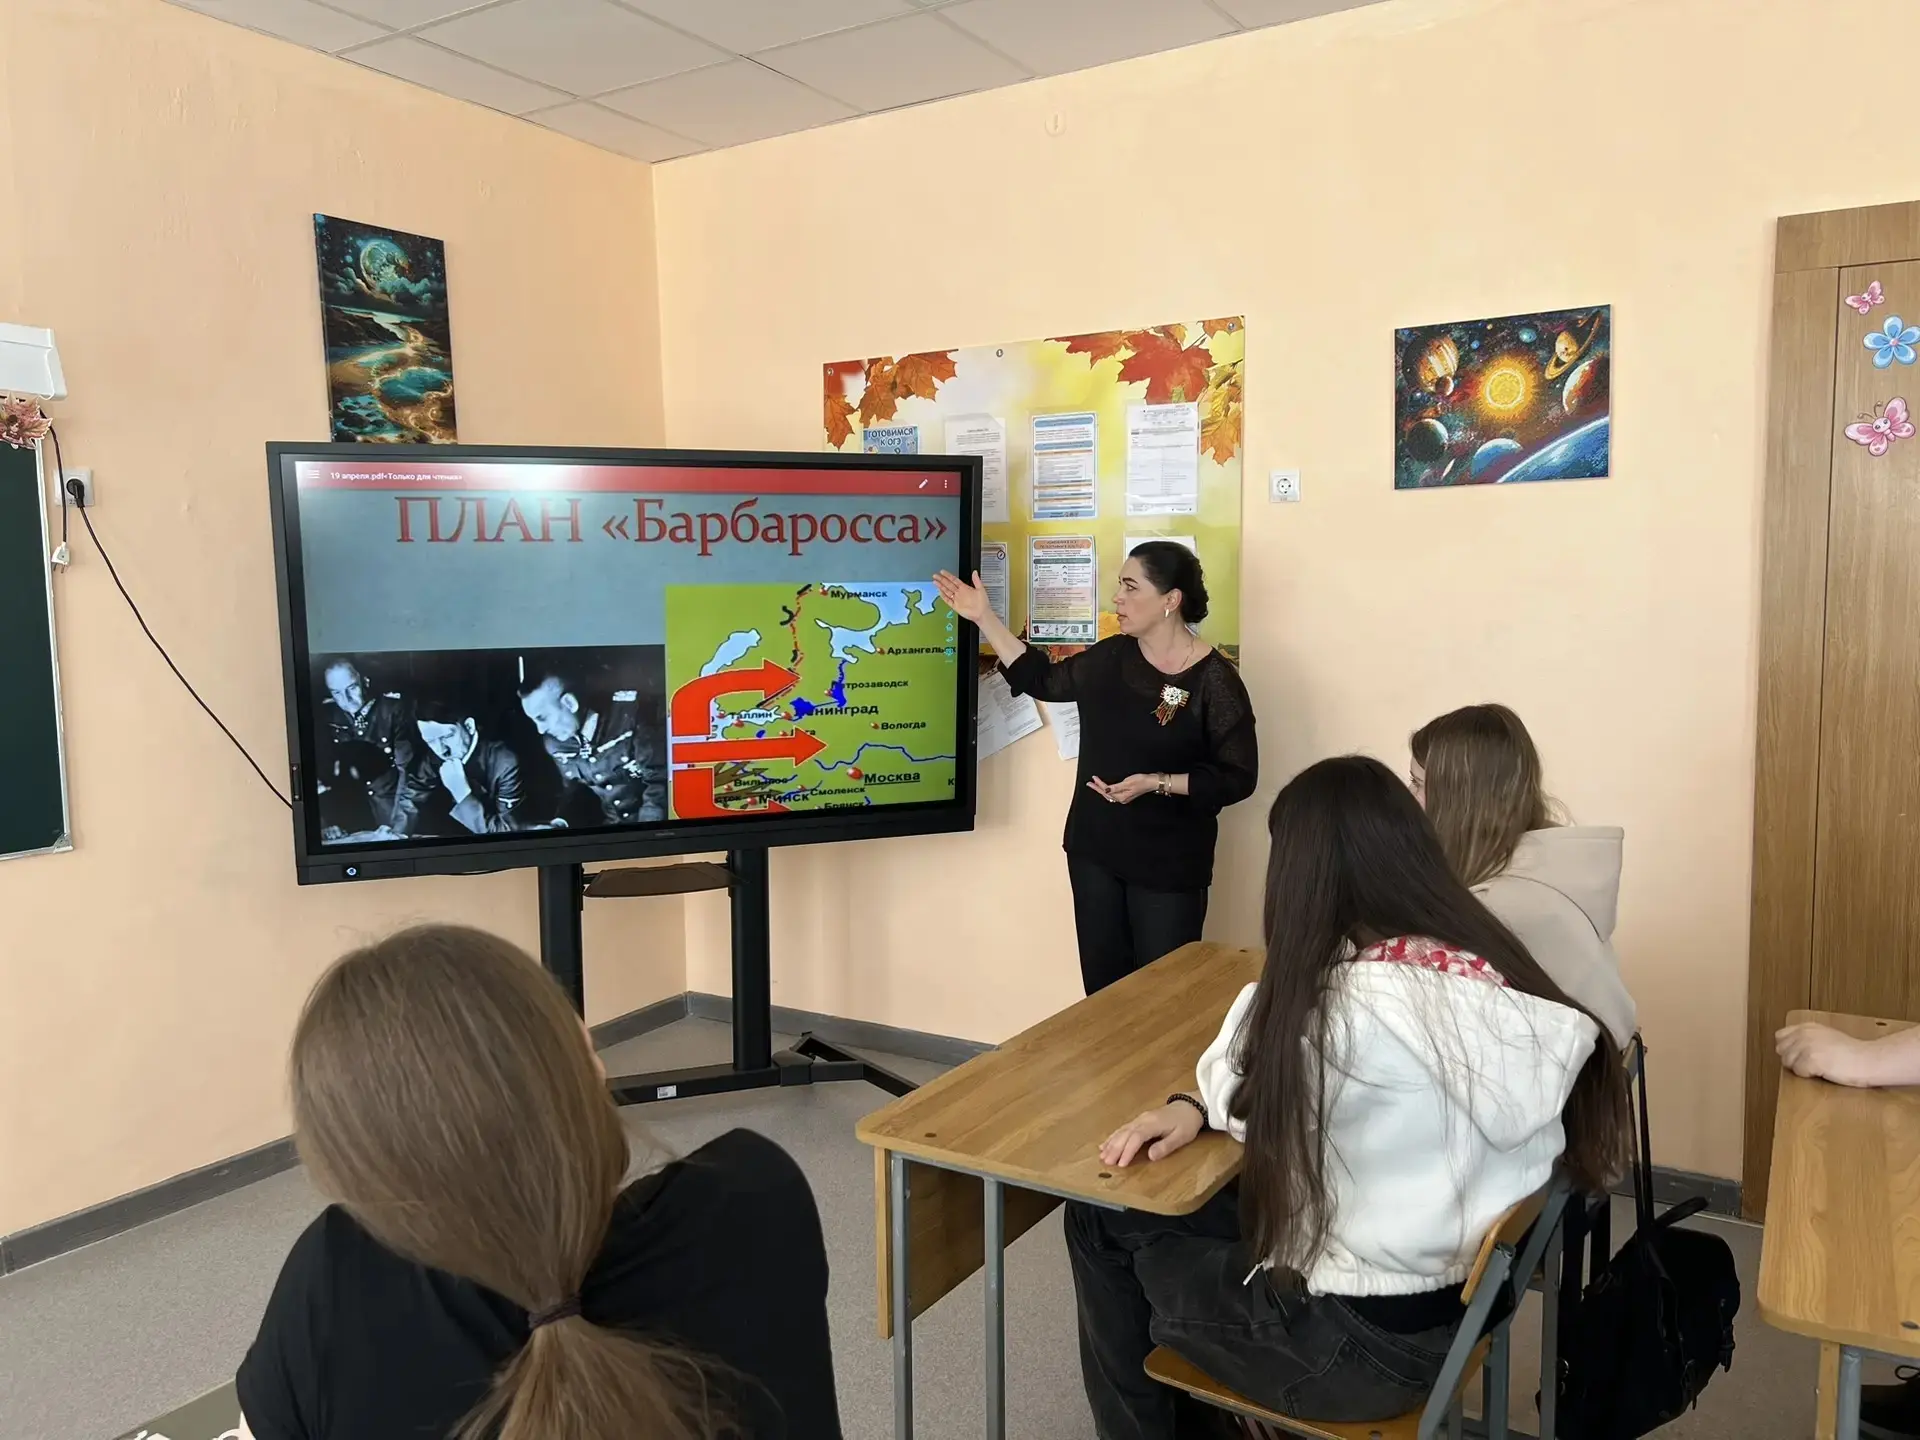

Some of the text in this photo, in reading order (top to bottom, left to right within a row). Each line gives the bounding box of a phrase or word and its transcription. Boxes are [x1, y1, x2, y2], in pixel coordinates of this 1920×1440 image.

[868, 428, 914, 438] ГОТОВИМСЯ
[887, 438, 902, 446] ОГЭ
[330, 472, 341, 480] 19
[416, 474, 432, 482] для
[395, 496, 948, 556] ПЛАН «Барбаросса»
[831, 590, 888, 599] Мурманск
[831, 680, 909, 690] Птрозаводск
[794, 705, 879, 717] нинград
[881, 721, 927, 730] Вологда
[864, 772, 921, 784] Москва
[810, 787, 866, 797] Смоленск
[759, 793, 810, 804] Минск
